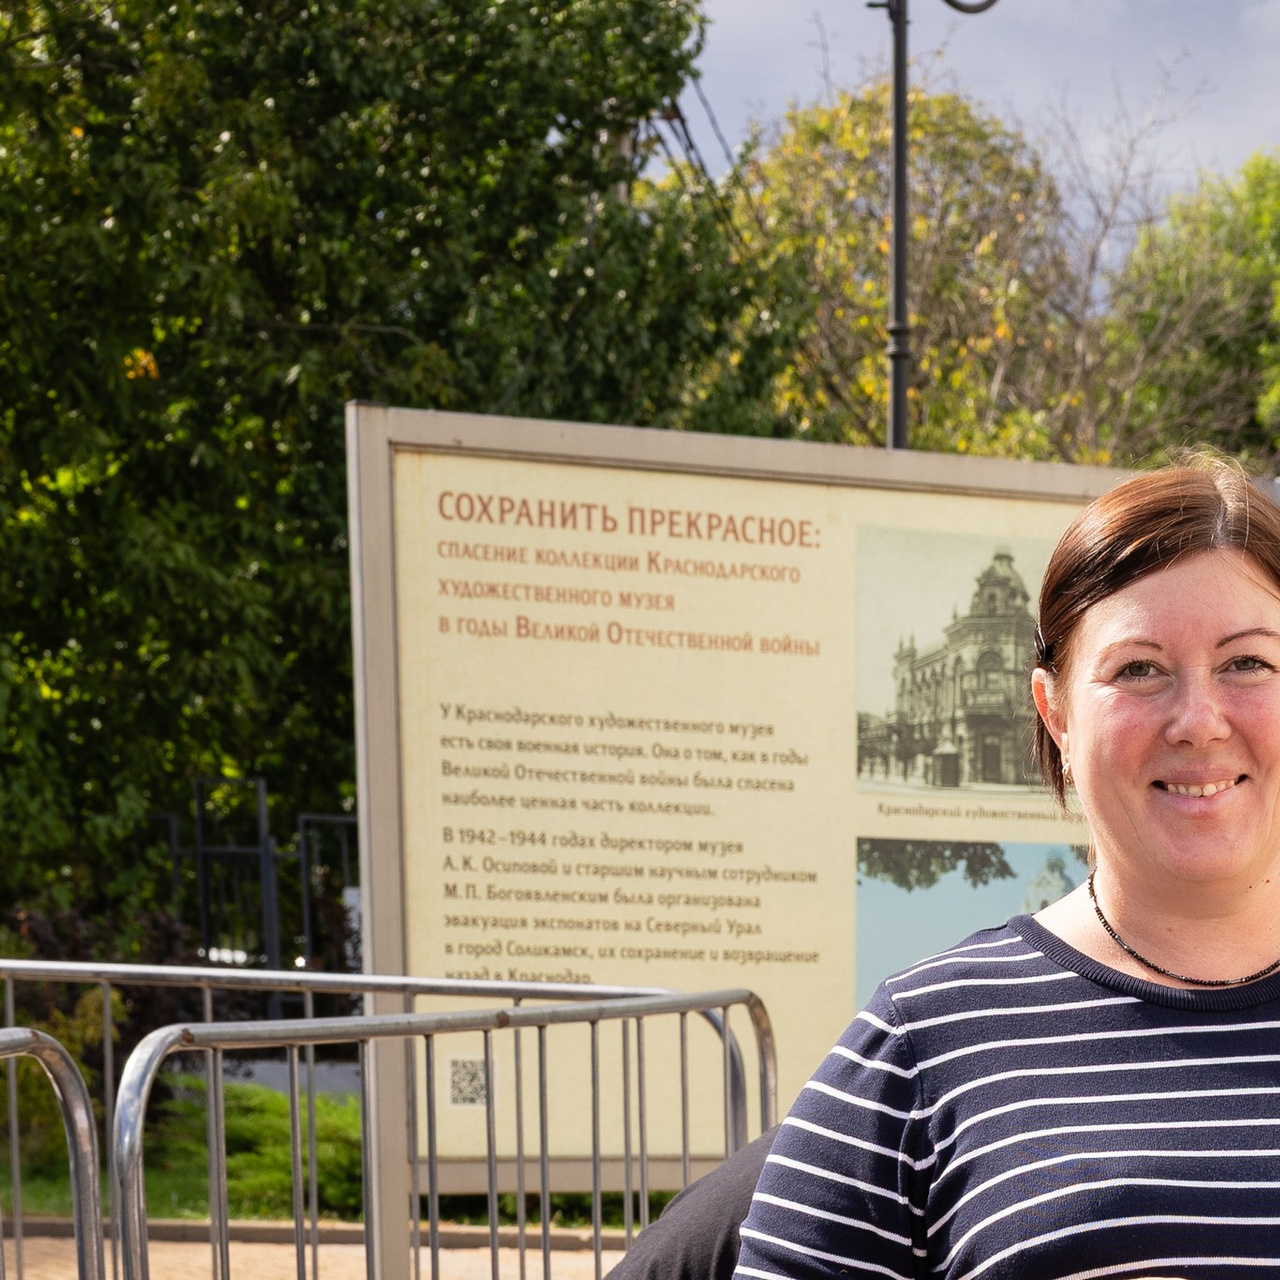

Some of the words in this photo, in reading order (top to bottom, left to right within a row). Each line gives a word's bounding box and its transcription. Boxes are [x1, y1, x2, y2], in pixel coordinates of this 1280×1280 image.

[438, 491, 618, 533] СОХРАНИТЬ
[628, 506, 822, 549] ПРЕКРАСНОЕ:
[439, 702, 451, 719] У
[455, 704, 584, 728] Краснодарского
[588, 711, 725, 734] художественного
[728, 723, 774, 740] музея
[440, 735, 475, 750] есть
[477, 738, 513, 751] своя
[516, 739, 580, 754] военная
[651, 742, 680, 760] Она
[683, 748, 692, 761] о
[731, 751, 756, 763] как
[760, 752, 769, 764] в
[772, 748, 808, 766] годы
[441, 759, 510, 779] Великой
[514, 763, 635, 785] Отечественной
[639, 770, 689, 788] войны
[692, 771, 733, 790] была
[737, 778, 795, 792] спасена
[442, 789, 516, 808] наиболее
[520, 796, 577, 810] ценная
[581, 799, 625, 813] часть
[443, 826, 454, 843] В
[552, 831, 596, 848] годах
[600, 832, 693, 854] директором
[698, 841, 743, 857] музея
[443, 855, 458, 871] А.
[462, 856, 479, 872] К.
[482, 856, 558, 875] Осиповой
[562, 864, 572, 876] и
[575, 863, 644, 880] старшим
[649, 866, 718, 881] научным
[722, 865, 818, 885] сотрудником
[444, 883, 463, 900] М.
[465, 883, 481, 900] П.
[486, 884, 609, 904] Богоявленским
[613, 887, 654, 905] была
[657, 894, 761, 911] организована
[444, 915, 528, 931] эвакуация
[533, 917, 620, 932] экспонатов
[624, 920, 642, 932] на
[646, 916, 722, 937] Северный
[726, 919, 762, 938] Урал
[445, 943, 454, 955] в
[458, 939, 503, 959] город
[598, 947, 616, 958] их
[620, 947, 706, 963] сохранение
[709, 949, 719, 961] и
[722, 950, 820, 966] возвращение
